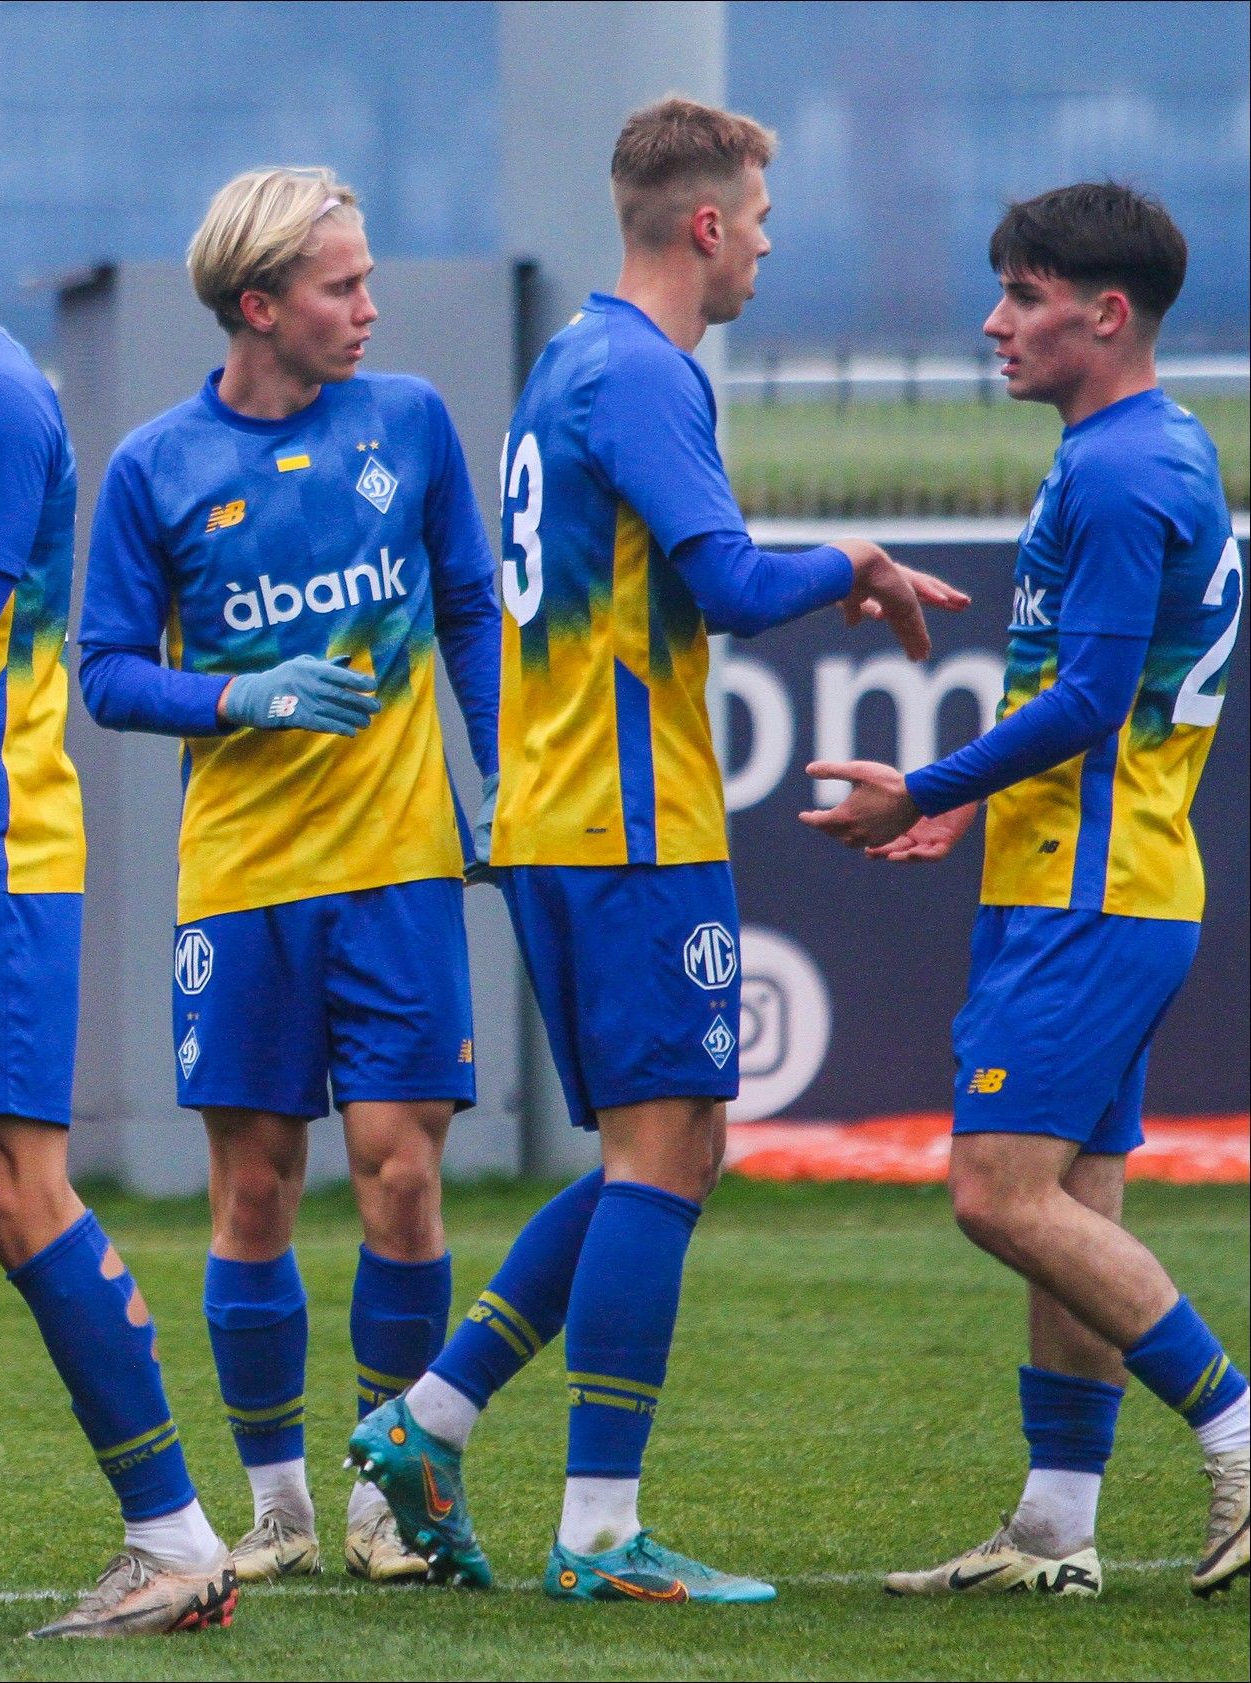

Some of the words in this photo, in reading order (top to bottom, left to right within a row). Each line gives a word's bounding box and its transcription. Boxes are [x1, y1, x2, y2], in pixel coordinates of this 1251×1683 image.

[500, 432, 544, 627] 3
[177, 934, 210, 989] MG
[688, 928, 734, 985] MG
